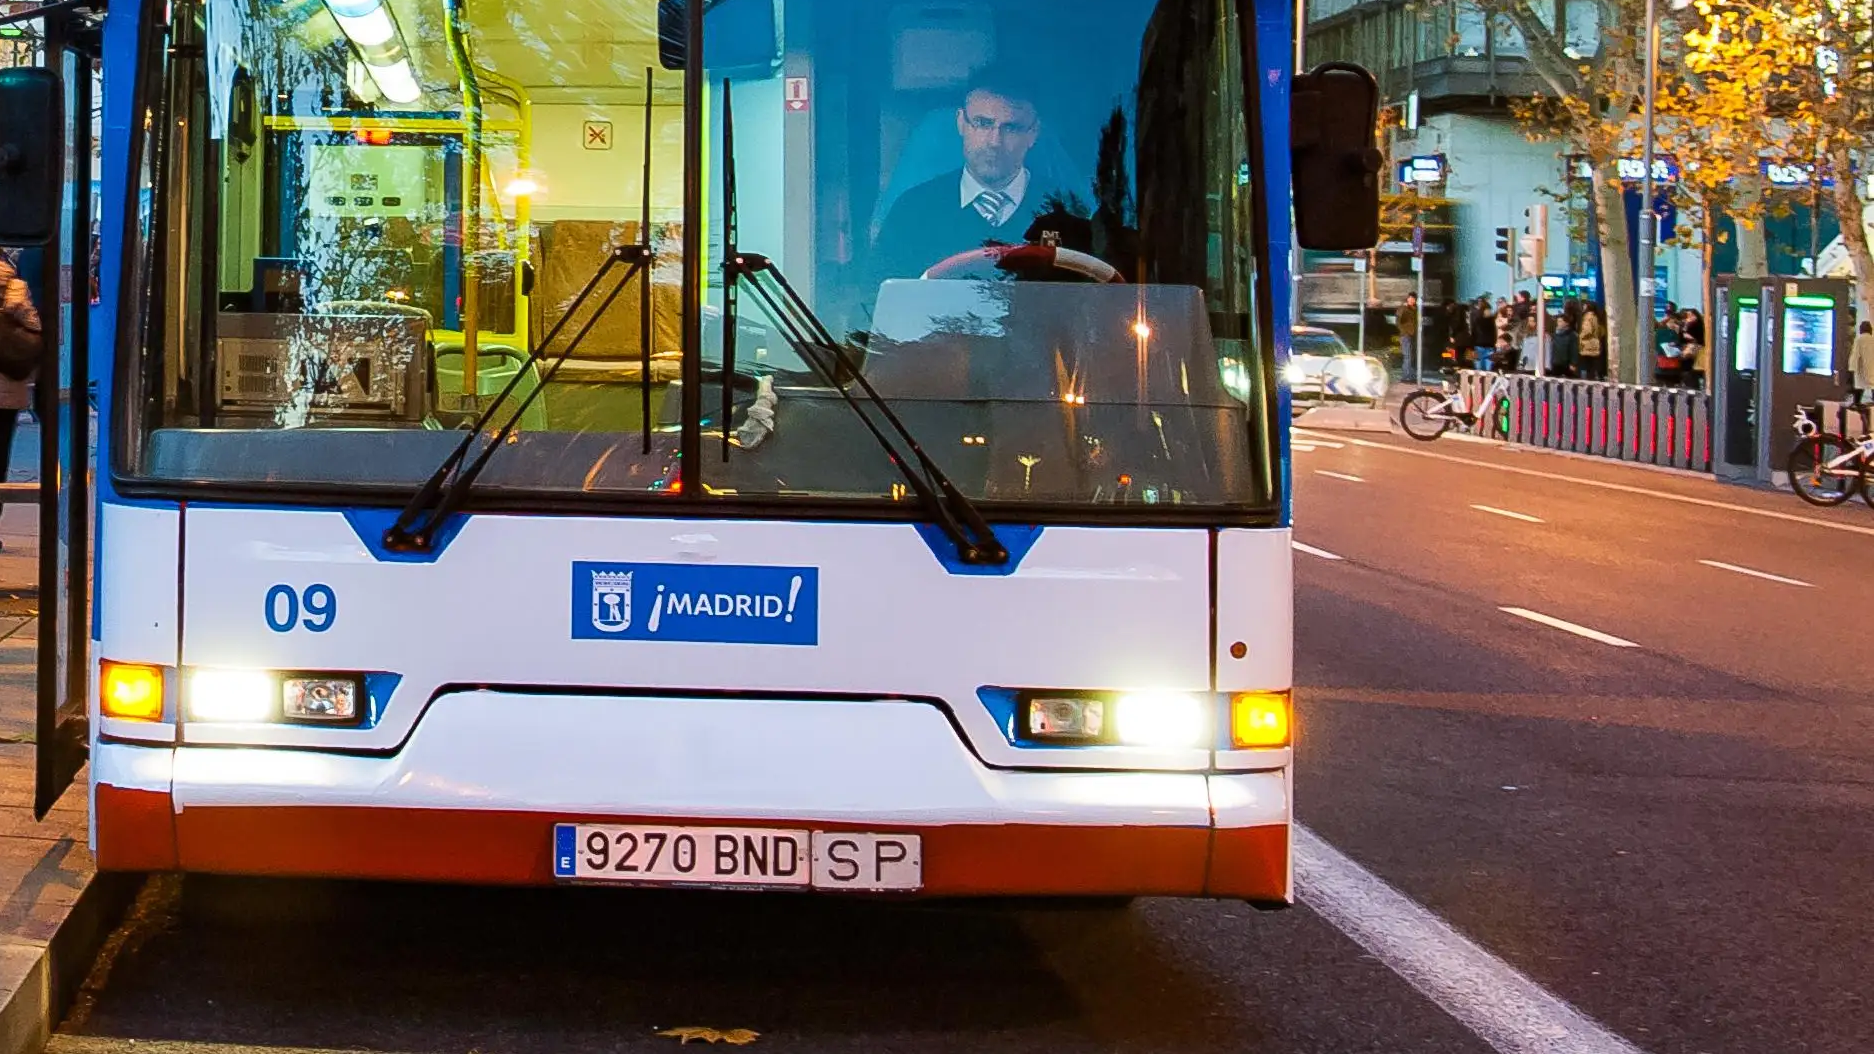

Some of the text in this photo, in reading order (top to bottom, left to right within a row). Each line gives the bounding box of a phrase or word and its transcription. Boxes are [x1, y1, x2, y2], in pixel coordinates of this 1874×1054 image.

[265, 584, 337, 632] 09
[648, 575, 802, 632] ¡MADRID!
[561, 856, 571, 868] E
[586, 831, 697, 873] 9270
[714, 834, 798, 877] BND
